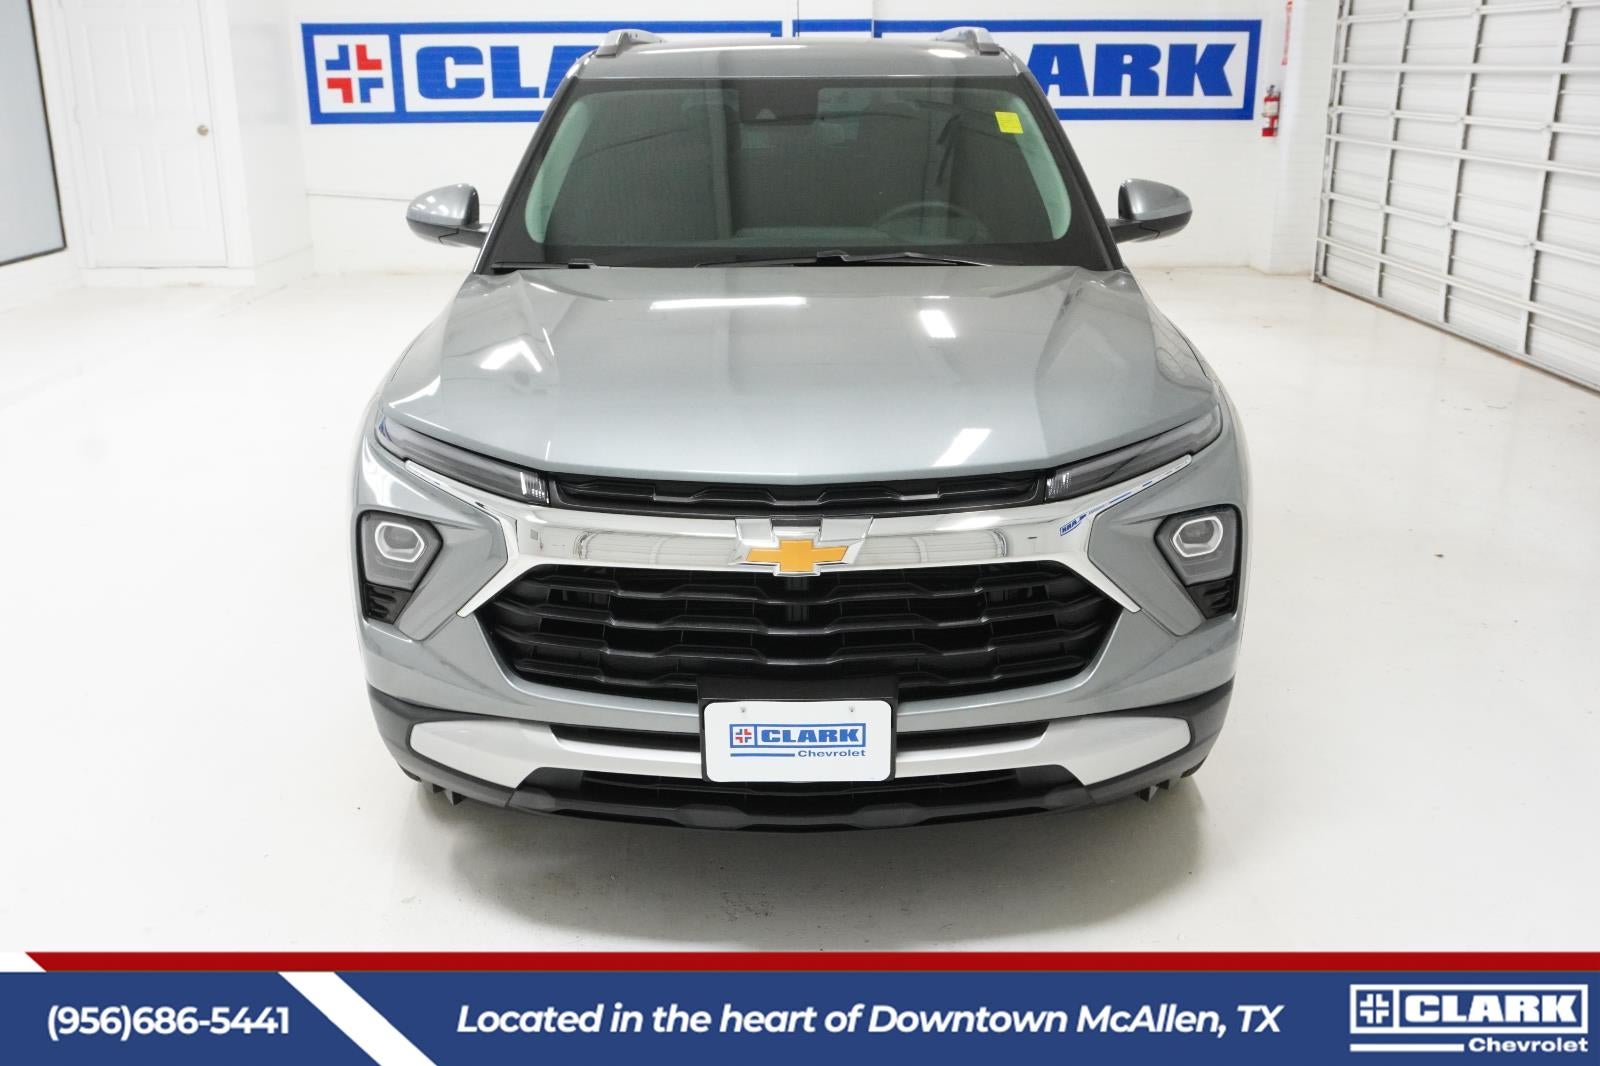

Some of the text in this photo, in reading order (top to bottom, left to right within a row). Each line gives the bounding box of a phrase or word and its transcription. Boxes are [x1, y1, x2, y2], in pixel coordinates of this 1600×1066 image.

[416, 45, 599, 99] CLA
[1027, 43, 1234, 97] ARK
[761, 728, 859, 743] CLARK
[797, 749, 866, 758] Chevrolet
